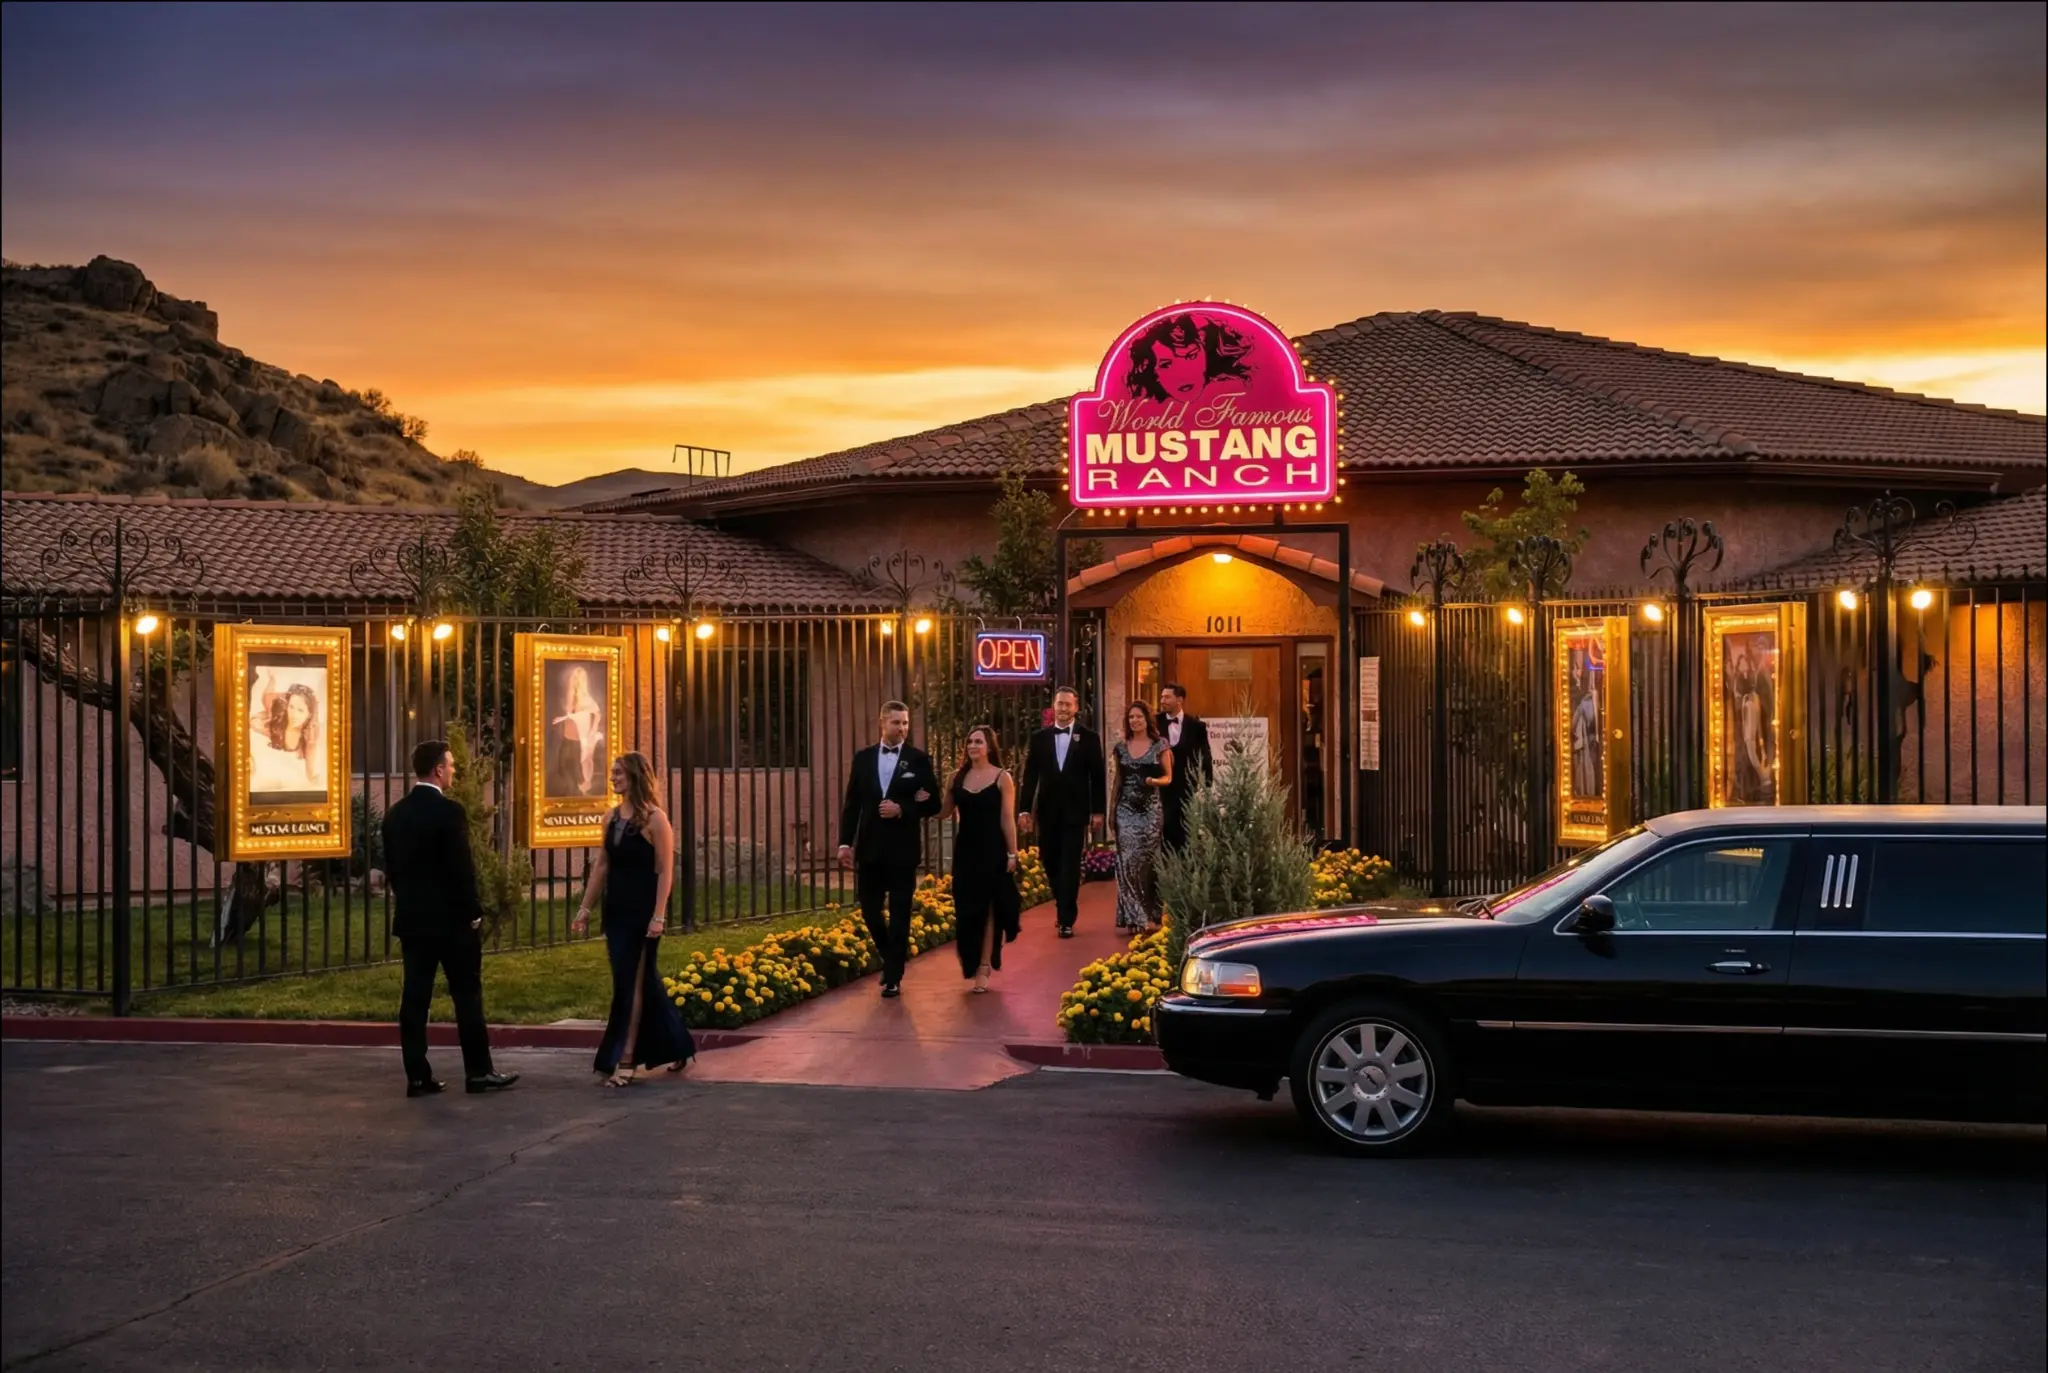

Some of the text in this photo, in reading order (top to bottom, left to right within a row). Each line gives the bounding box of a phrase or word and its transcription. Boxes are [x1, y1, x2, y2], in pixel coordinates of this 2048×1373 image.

[1098, 392, 1313, 431] World Famous
[1086, 425, 1318, 464] MUSTANG
[1088, 463, 1319, 490] RANCH
[1206, 615, 1242, 634] 1011
[978, 638, 1041, 671] OPEN
